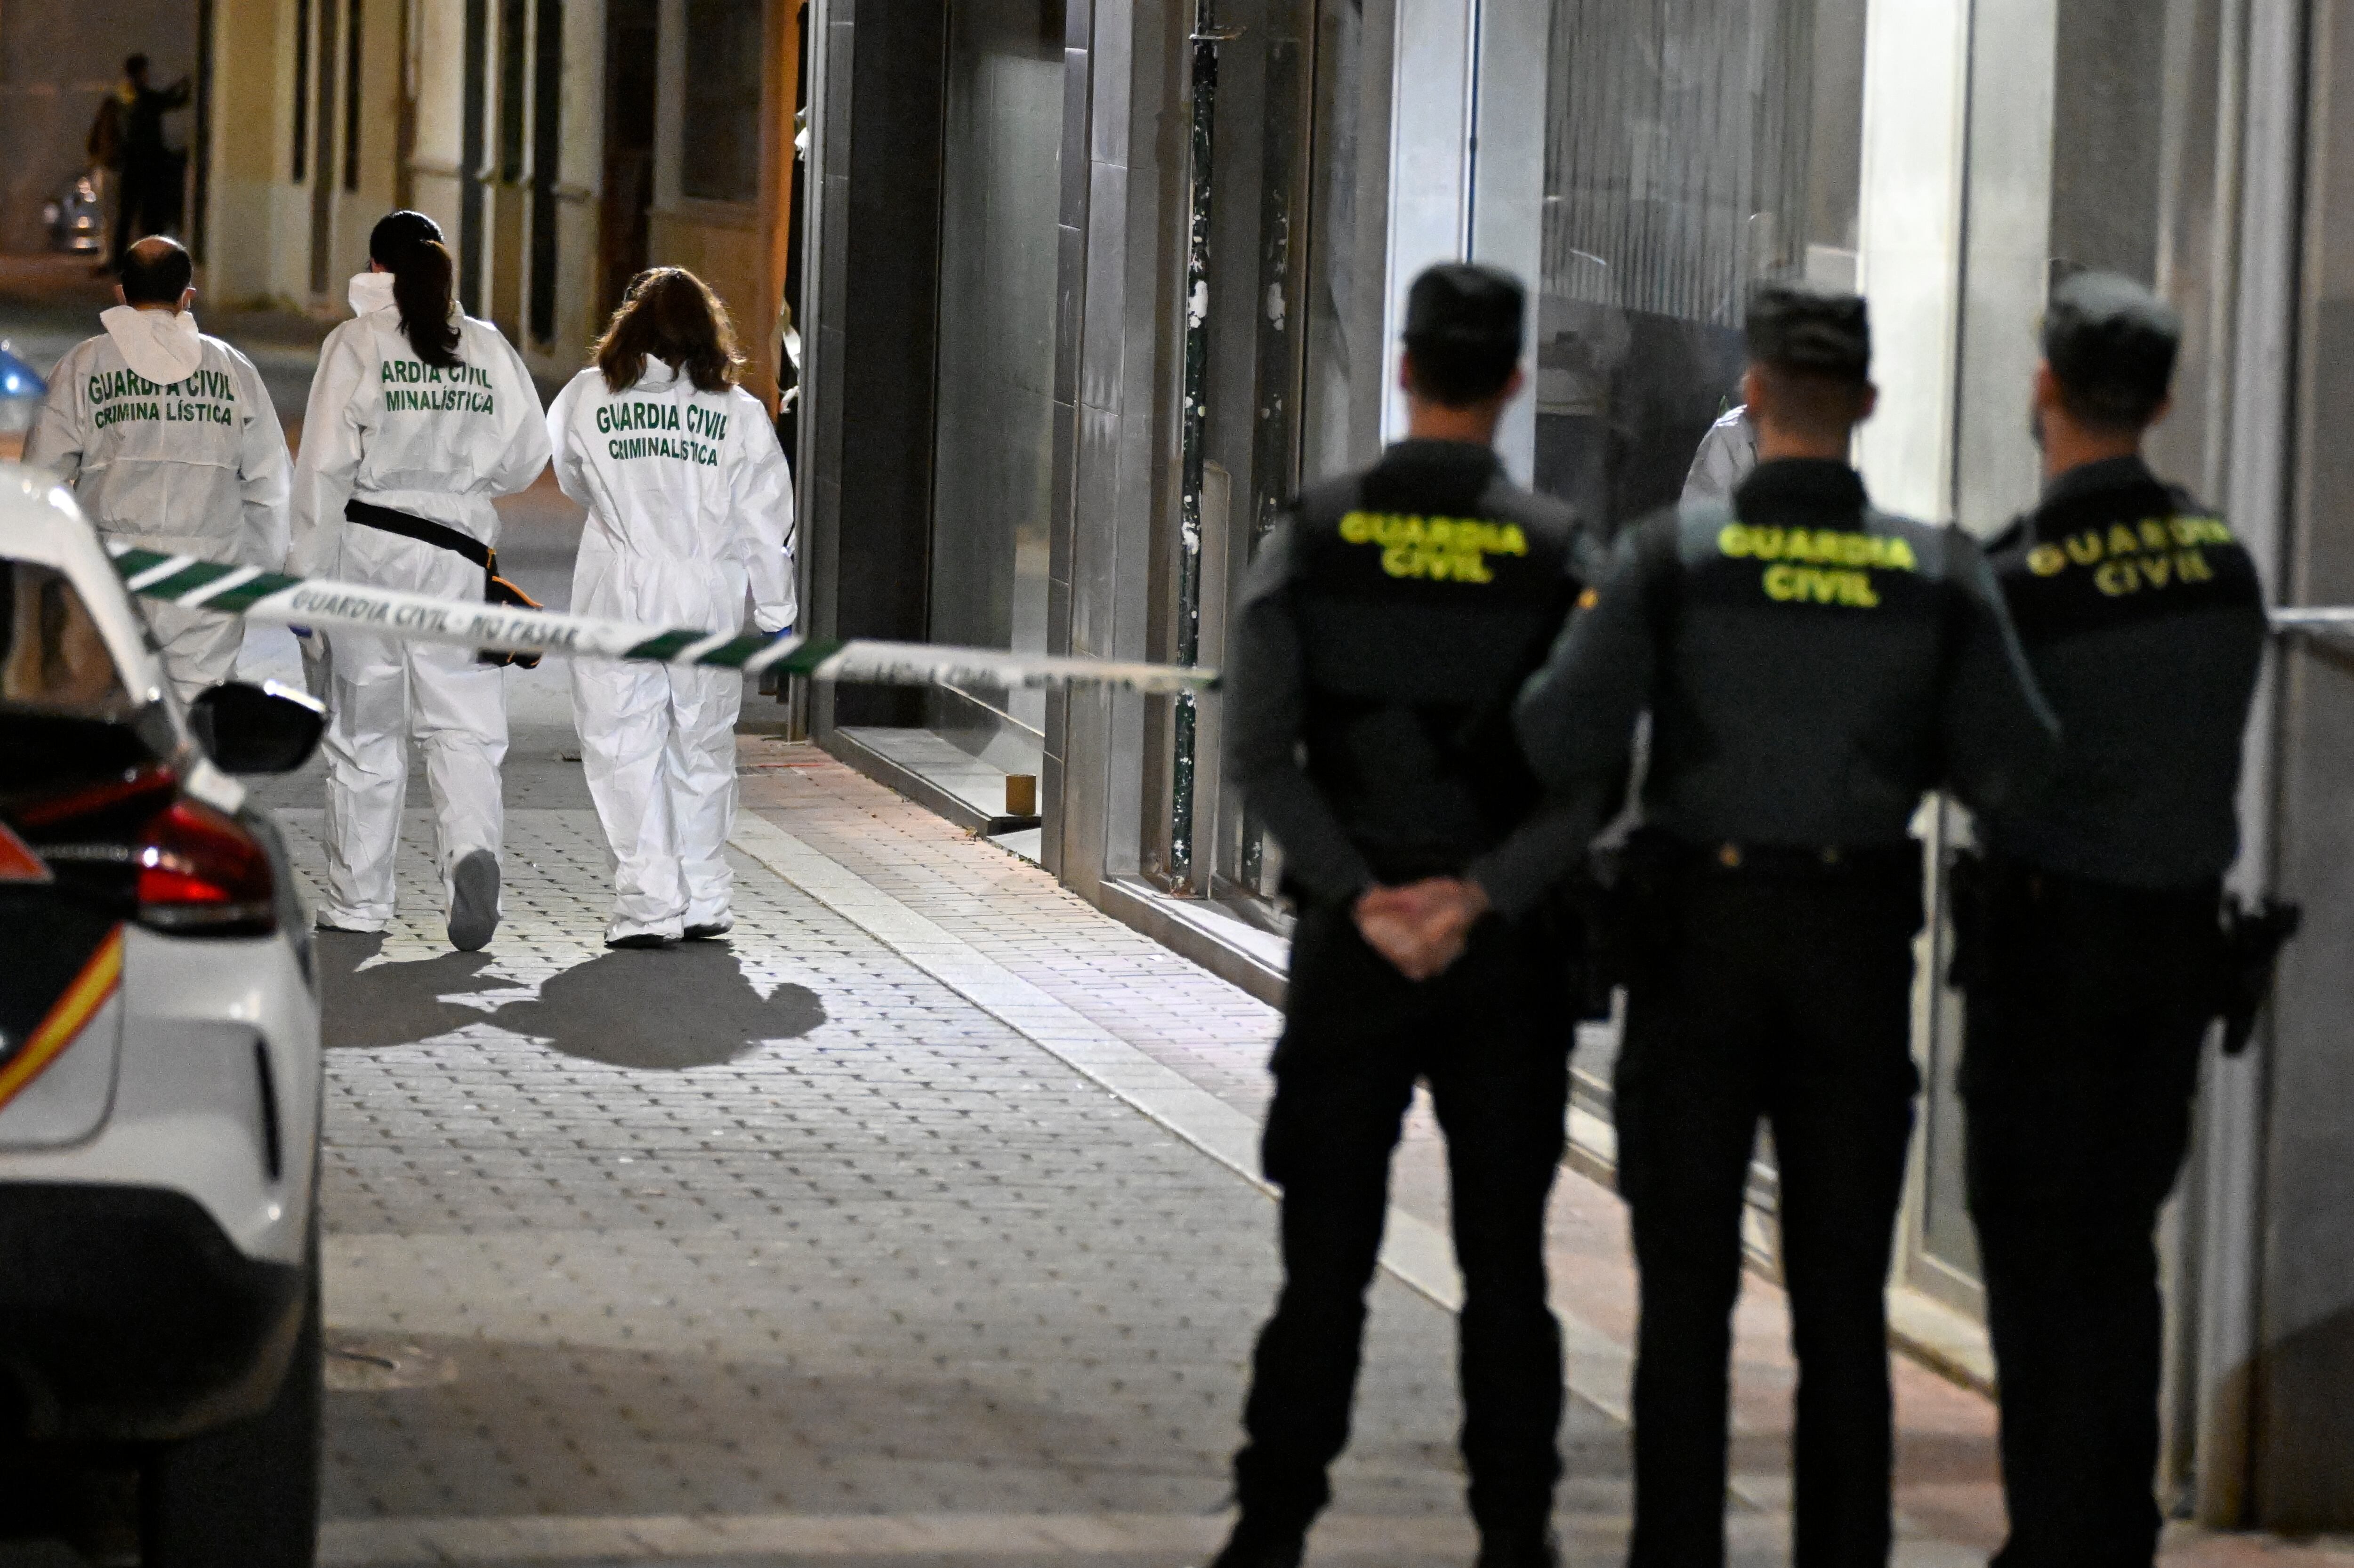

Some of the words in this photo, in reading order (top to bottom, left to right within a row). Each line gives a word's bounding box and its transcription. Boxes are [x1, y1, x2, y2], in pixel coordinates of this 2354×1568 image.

[186, 370, 235, 402] CIVIL
[382, 360, 442, 383] ARDIA
[386, 385, 493, 415] MINALÍSTICA
[596, 402, 680, 434] GUARDIA
[687, 404, 727, 441] CIVIL
[1340, 511, 1527, 555] GUARDIA
[1718, 523, 1916, 570] GUARDIA
[2026, 516, 2233, 577] GUARDIA
[1383, 547, 1493, 583] CIVIL
[2094, 550, 2213, 596] CIVIL
[1763, 565, 1880, 607] CIVIL
[292, 589, 390, 623] GUARDIA
